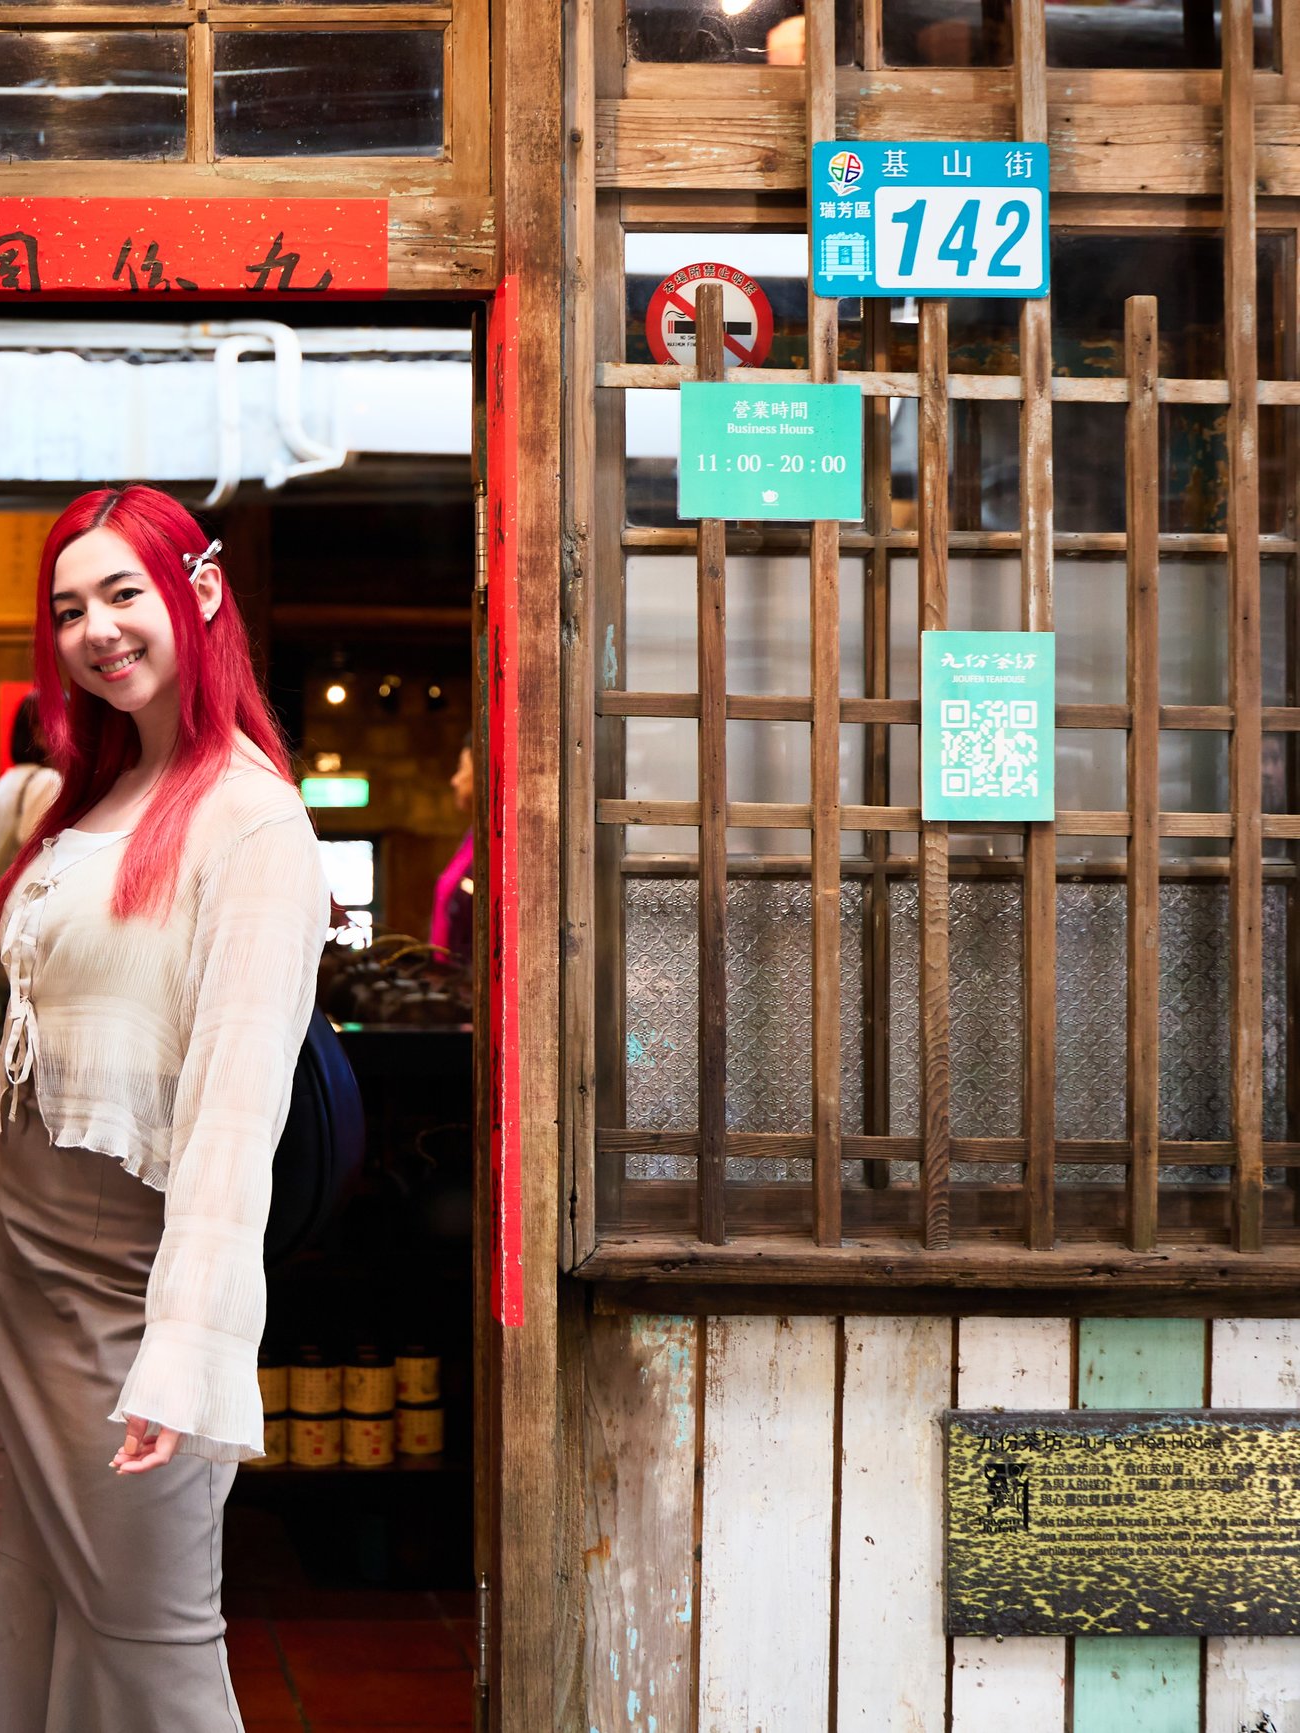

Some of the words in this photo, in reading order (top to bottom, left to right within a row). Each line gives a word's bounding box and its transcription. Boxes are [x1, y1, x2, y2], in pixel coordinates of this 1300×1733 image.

[882, 149, 1033, 178] 基山街
[819, 201, 871, 219] 瑞芳區
[891, 199, 1030, 277] 142
[732, 400, 808, 420] 營業時間
[727, 423, 777, 434] Business
[779, 424, 814, 435] Hours
[940, 652, 1037, 670] 九份茶坊
[986, 675, 1026, 684] TEAHOUSE
[977, 1432, 1063, 1452] 九份茶坊
[1075, 1435, 1133, 1449] Jiu-Fen
[1139, 1435, 1166, 1449] Tea
[1173, 1435, 1222, 1449] House
